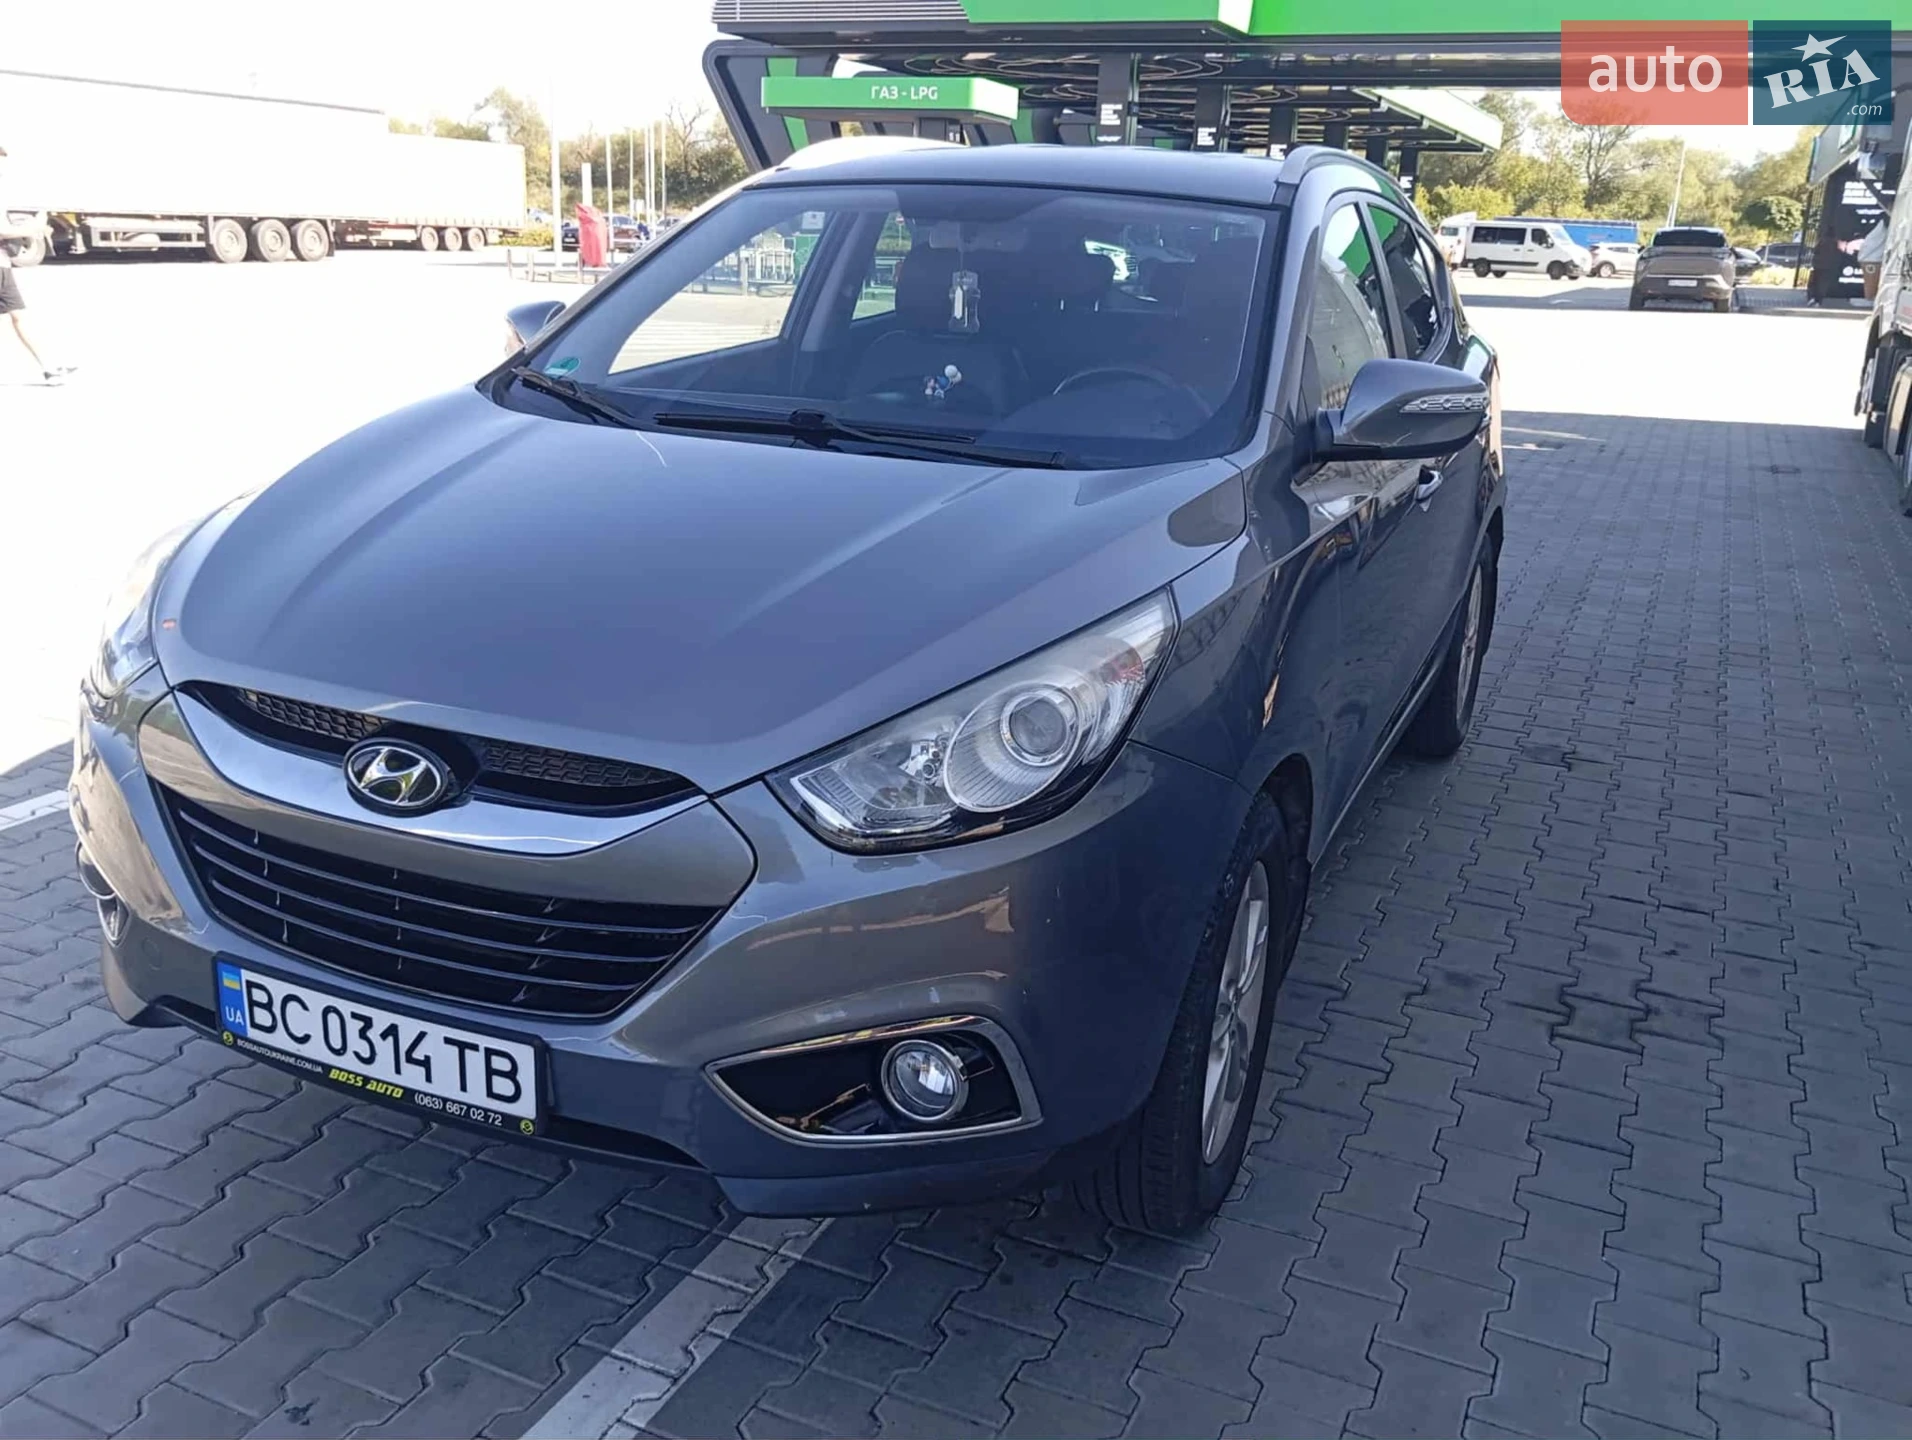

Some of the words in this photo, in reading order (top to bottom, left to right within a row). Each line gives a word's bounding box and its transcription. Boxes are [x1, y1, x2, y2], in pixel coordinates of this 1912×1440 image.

[871, 86, 898, 99] ГАЗ
[910, 86, 938, 100] LPG
[225, 1005, 245, 1026] UA
[329, 1068, 364, 1087] BOSS
[414, 1091, 443, 1110] (063)
[446, 1101, 467, 1116] 667
[470, 1108, 485, 1121] 02
[488, 1112, 503, 1126] 72
